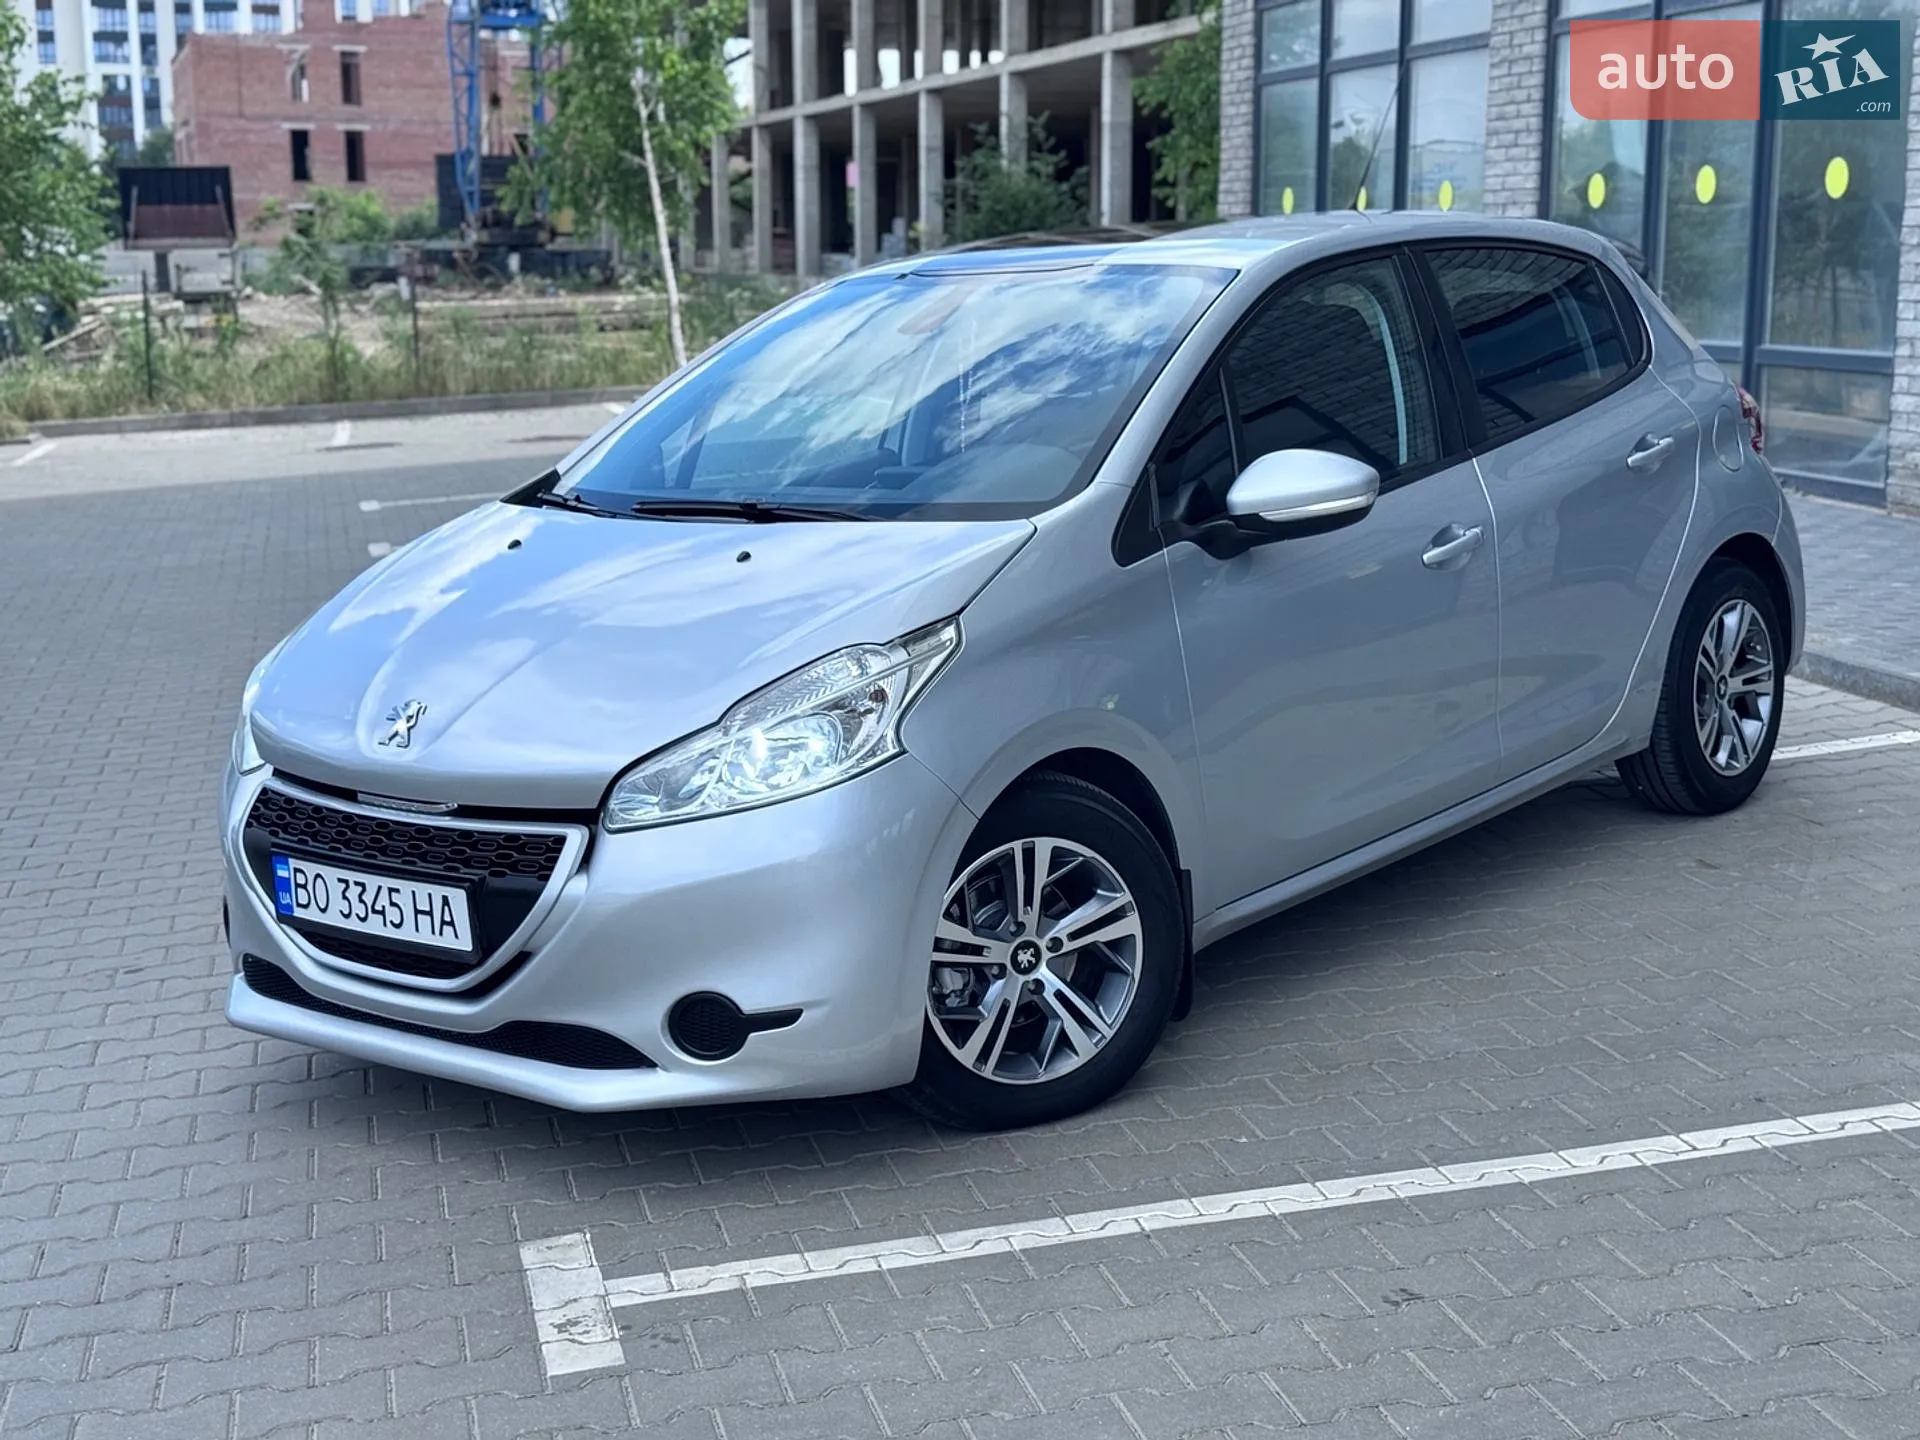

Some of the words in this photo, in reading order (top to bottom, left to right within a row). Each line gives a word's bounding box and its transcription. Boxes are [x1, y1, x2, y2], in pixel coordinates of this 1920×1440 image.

[279, 891, 292, 905] UA
[293, 867, 329, 913] BO
[338, 878, 404, 928] 3345
[412, 890, 459, 939] HA
